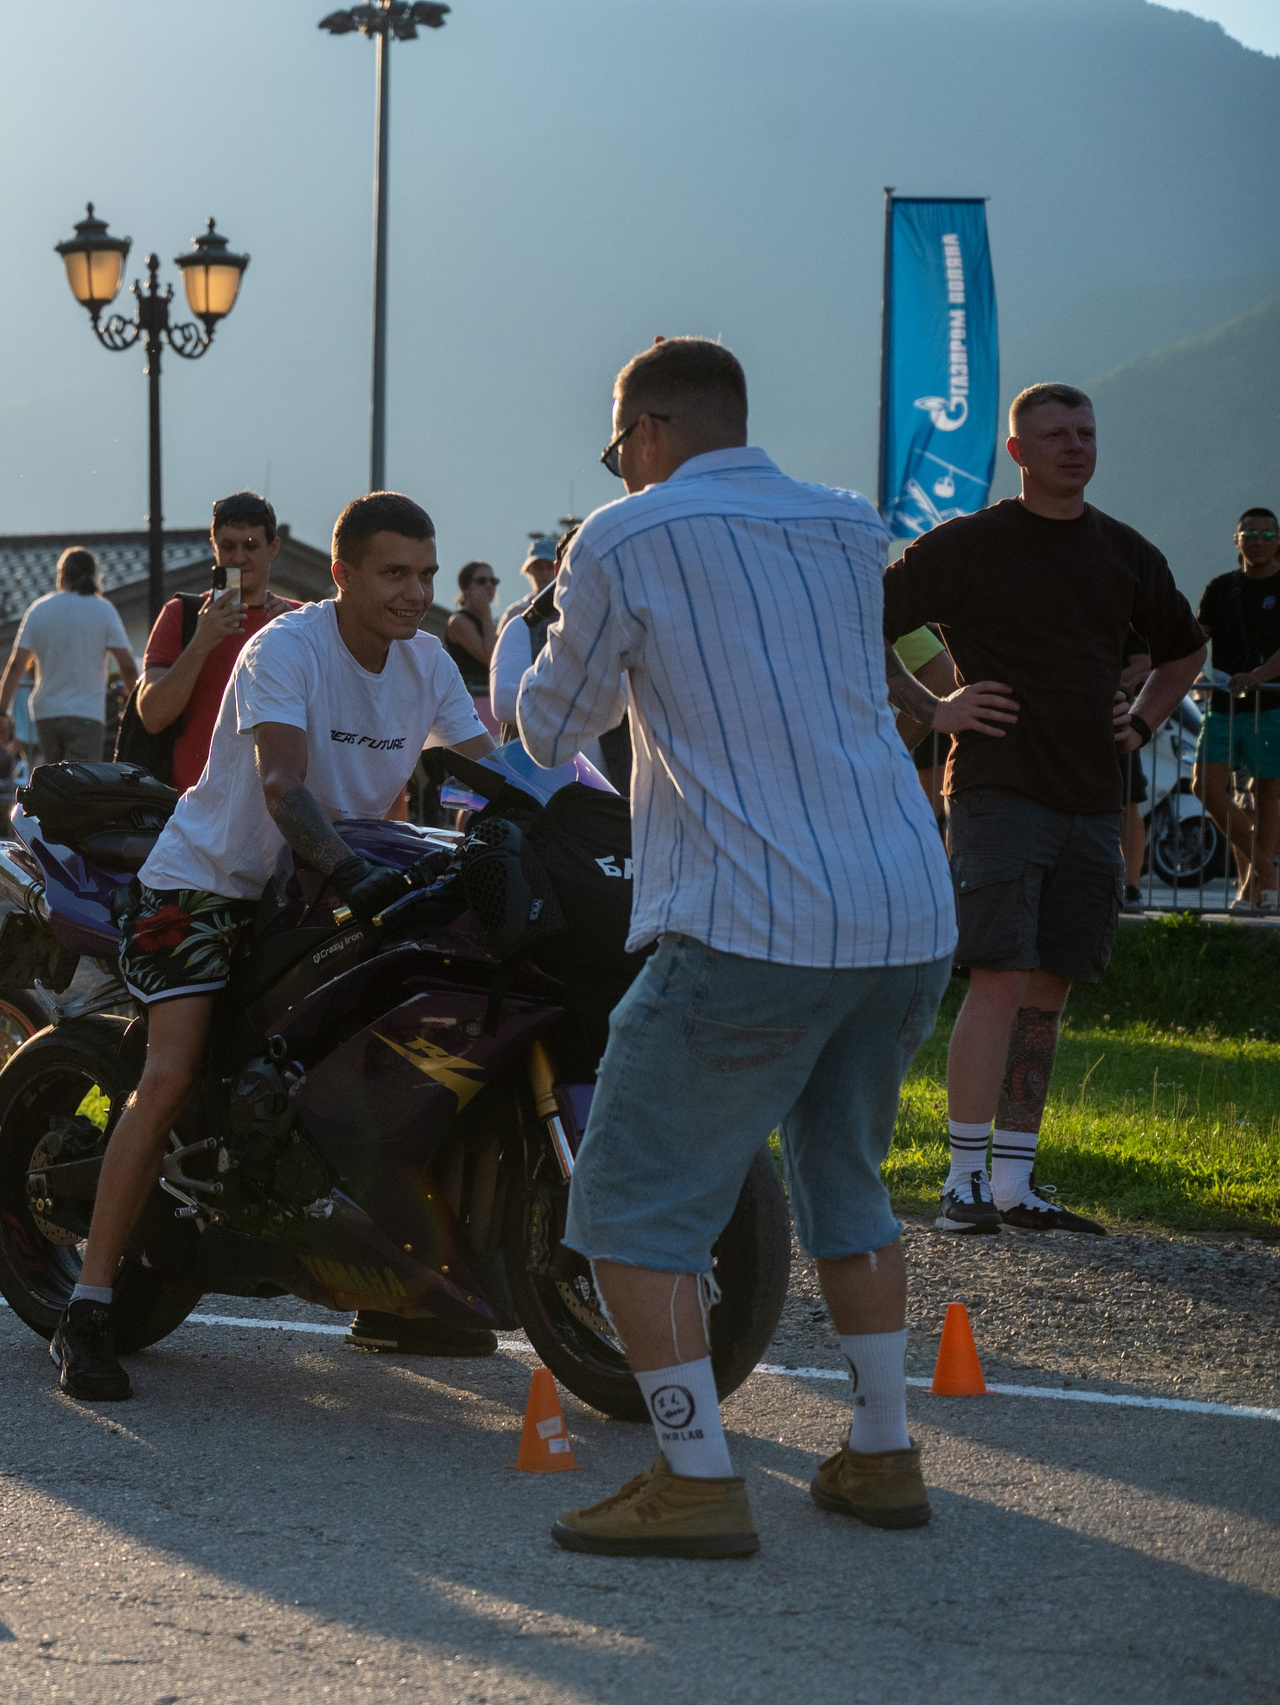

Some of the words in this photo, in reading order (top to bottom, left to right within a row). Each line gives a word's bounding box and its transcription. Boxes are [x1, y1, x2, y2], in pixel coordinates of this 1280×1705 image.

[949, 309, 969, 397] ГАЗПРОМ
[358, 735, 407, 750] FUTURE
[320, 941, 344, 958] Crazy
[344, 931, 363, 945] Iron
[298, 1254, 408, 1298] YAMAHA
